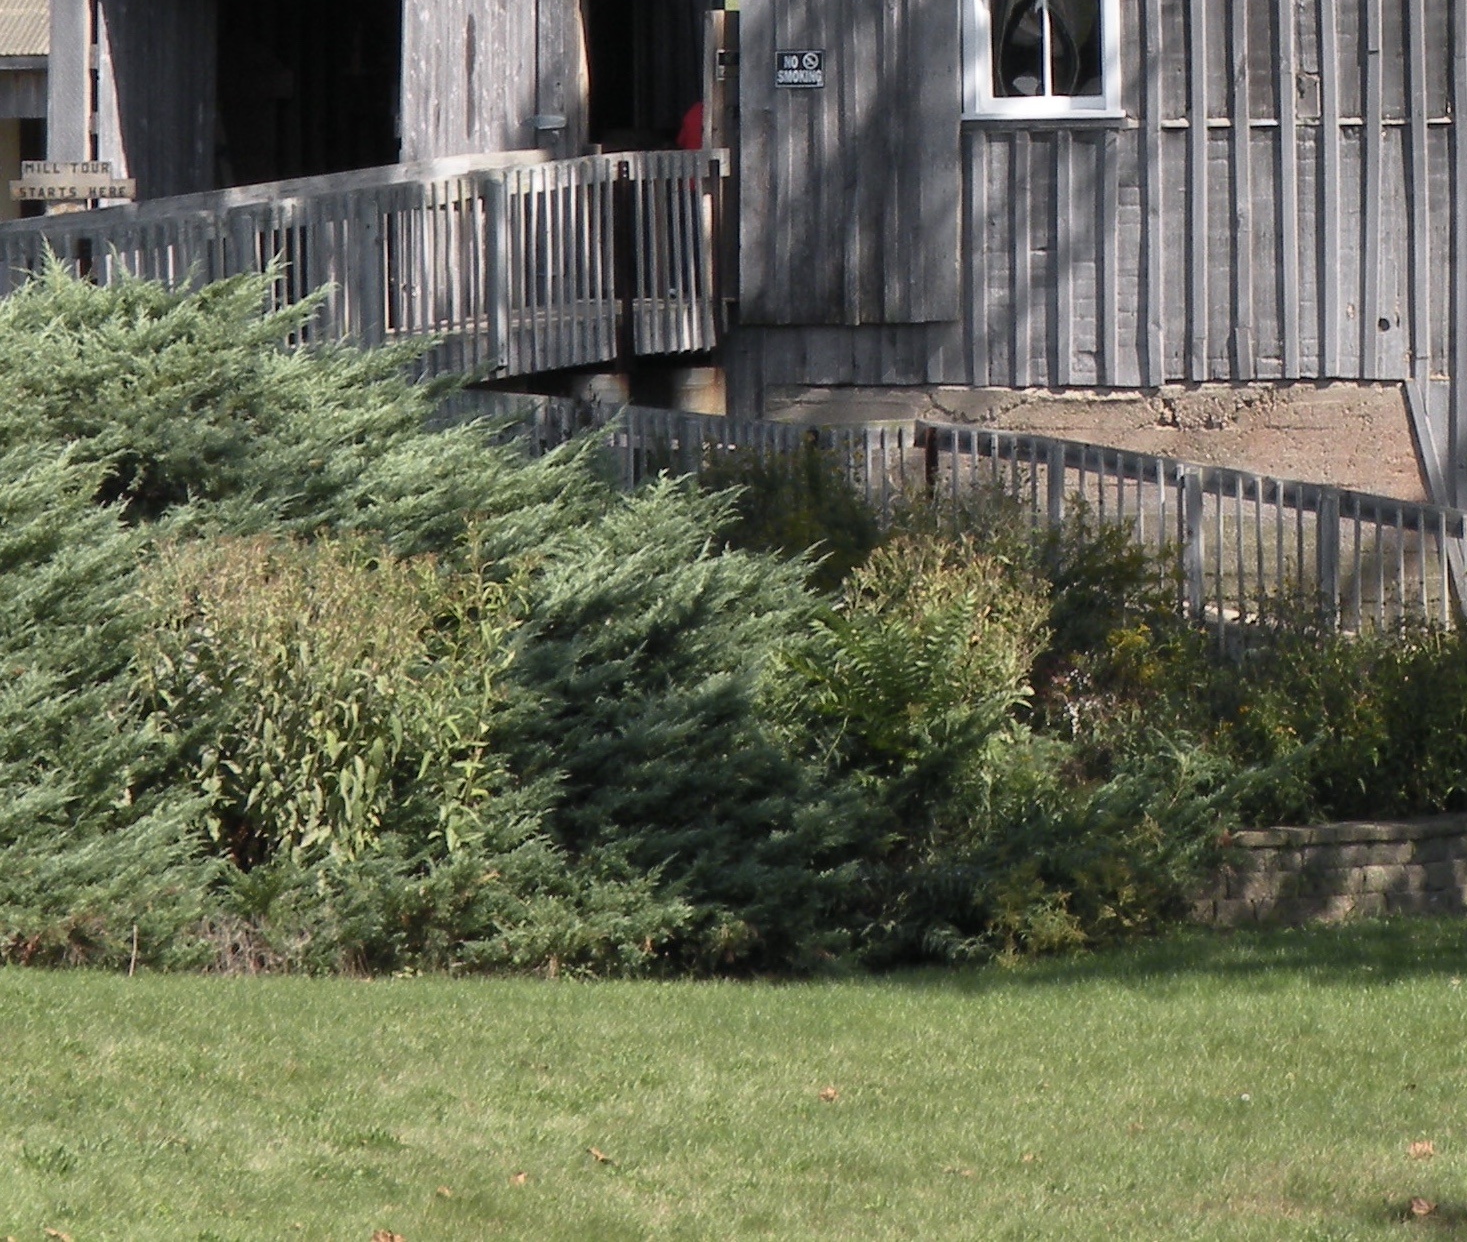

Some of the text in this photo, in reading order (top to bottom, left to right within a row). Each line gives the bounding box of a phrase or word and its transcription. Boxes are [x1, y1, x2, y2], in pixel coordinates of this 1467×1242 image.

[783, 55, 799, 69] NO
[777, 69, 822, 84] SMOKING
[24, 162, 111, 174] MILL TOUR
[19, 185, 126, 198] STARTS HERE
